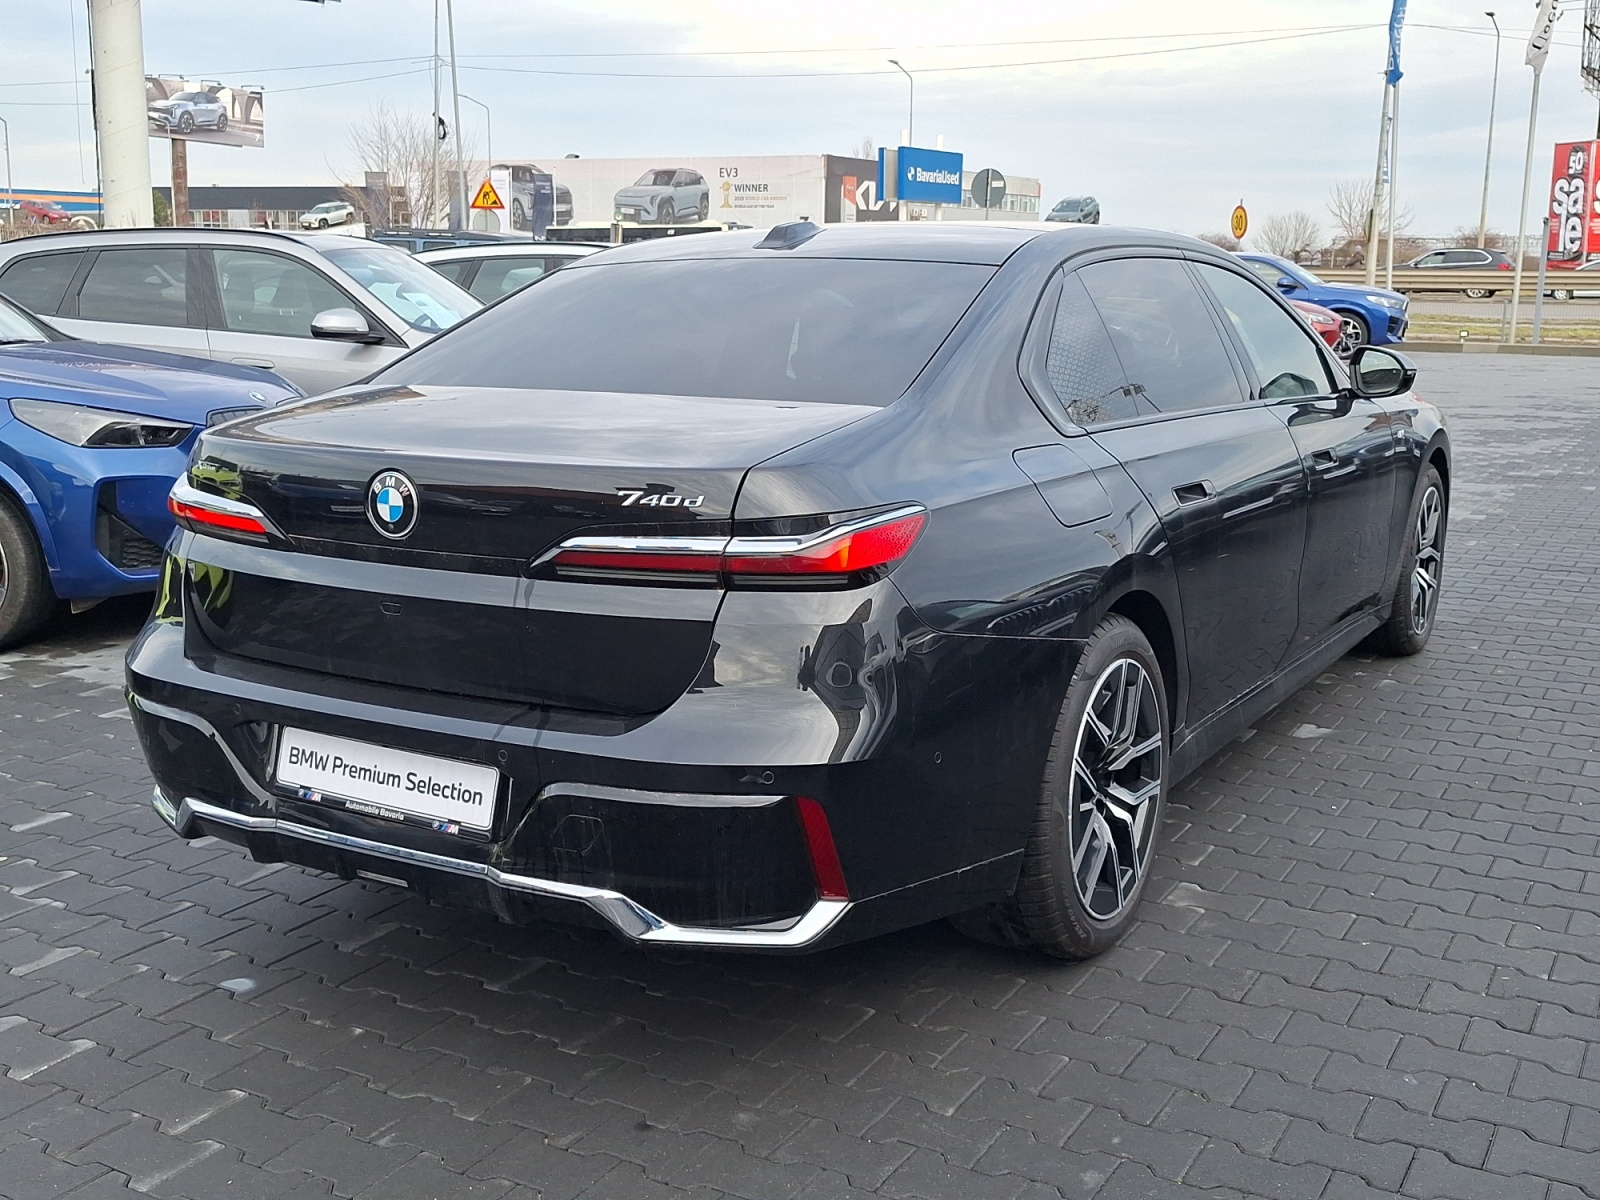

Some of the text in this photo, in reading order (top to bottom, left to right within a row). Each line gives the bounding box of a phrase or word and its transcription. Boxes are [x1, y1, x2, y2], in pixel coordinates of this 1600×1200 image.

[719, 167, 739, 178] EV3
[916, 167, 960, 185] BavariaUsed
[734, 183, 769, 193] WINNER
[1234, 214, 1243, 231] 30
[373, 476, 411, 498] BMW
[617, 490, 705, 508] 740d
[288, 746, 483, 806] BMW Premium Selection
[345, 800, 405, 821] Automobile Bavaria
